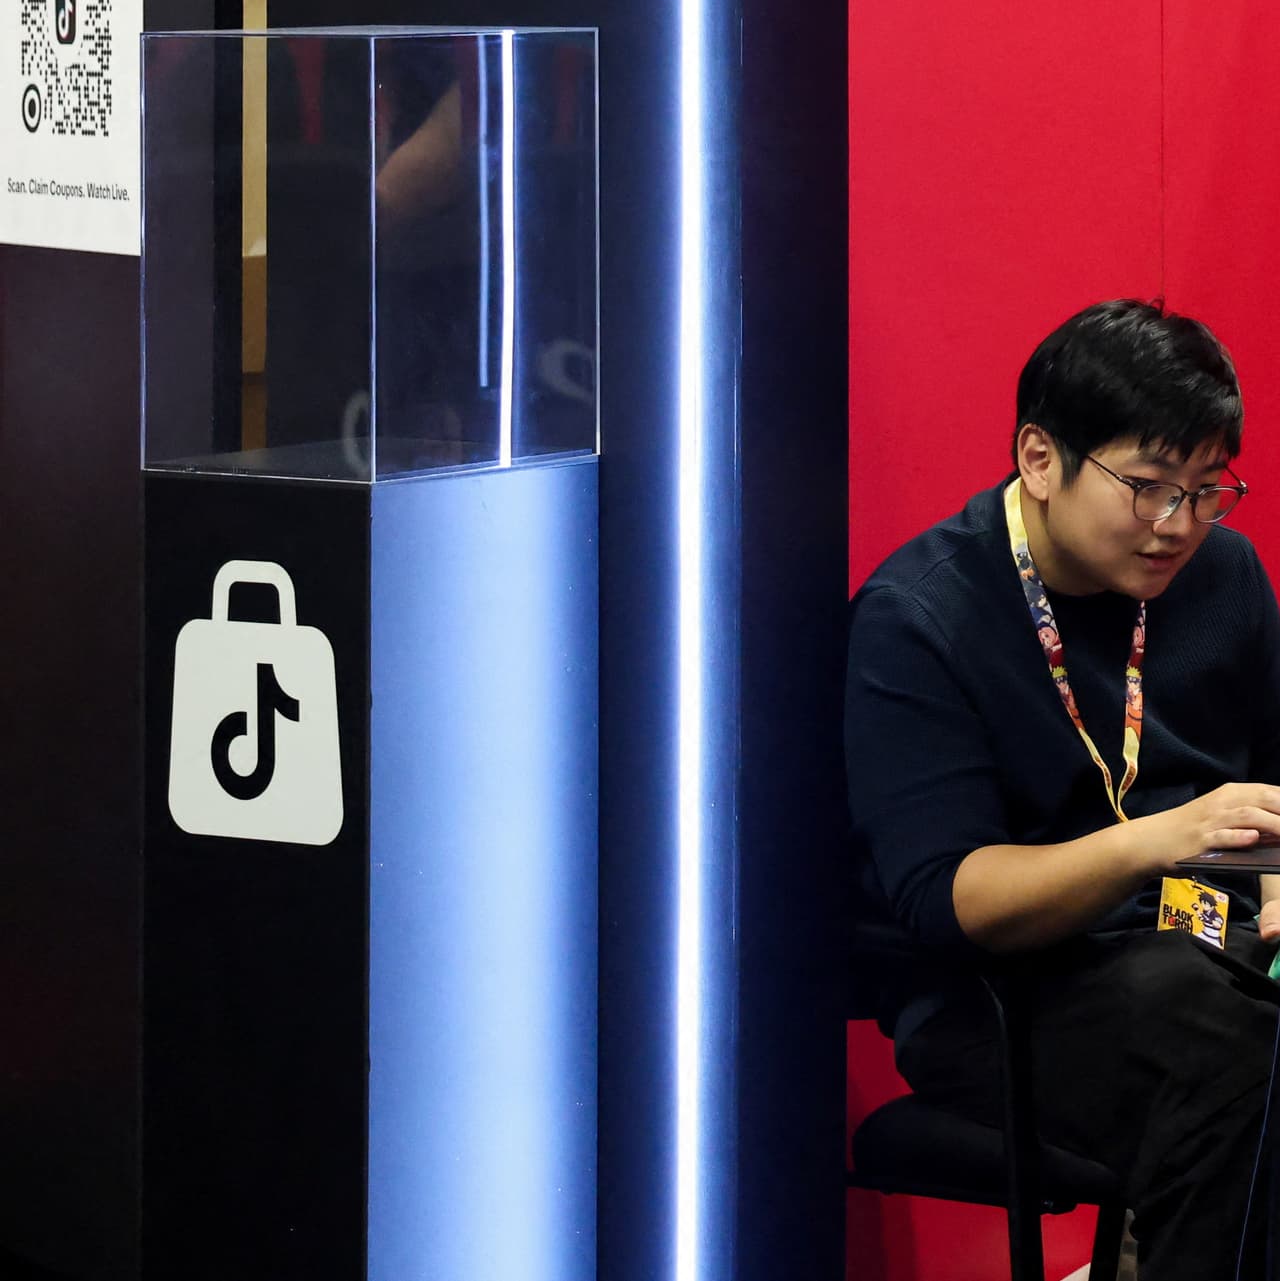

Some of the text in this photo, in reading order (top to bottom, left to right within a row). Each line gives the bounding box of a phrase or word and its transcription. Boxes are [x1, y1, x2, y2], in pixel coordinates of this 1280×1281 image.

[7, 177, 130, 201] Scan. Claim Coupons. Watch Live.
